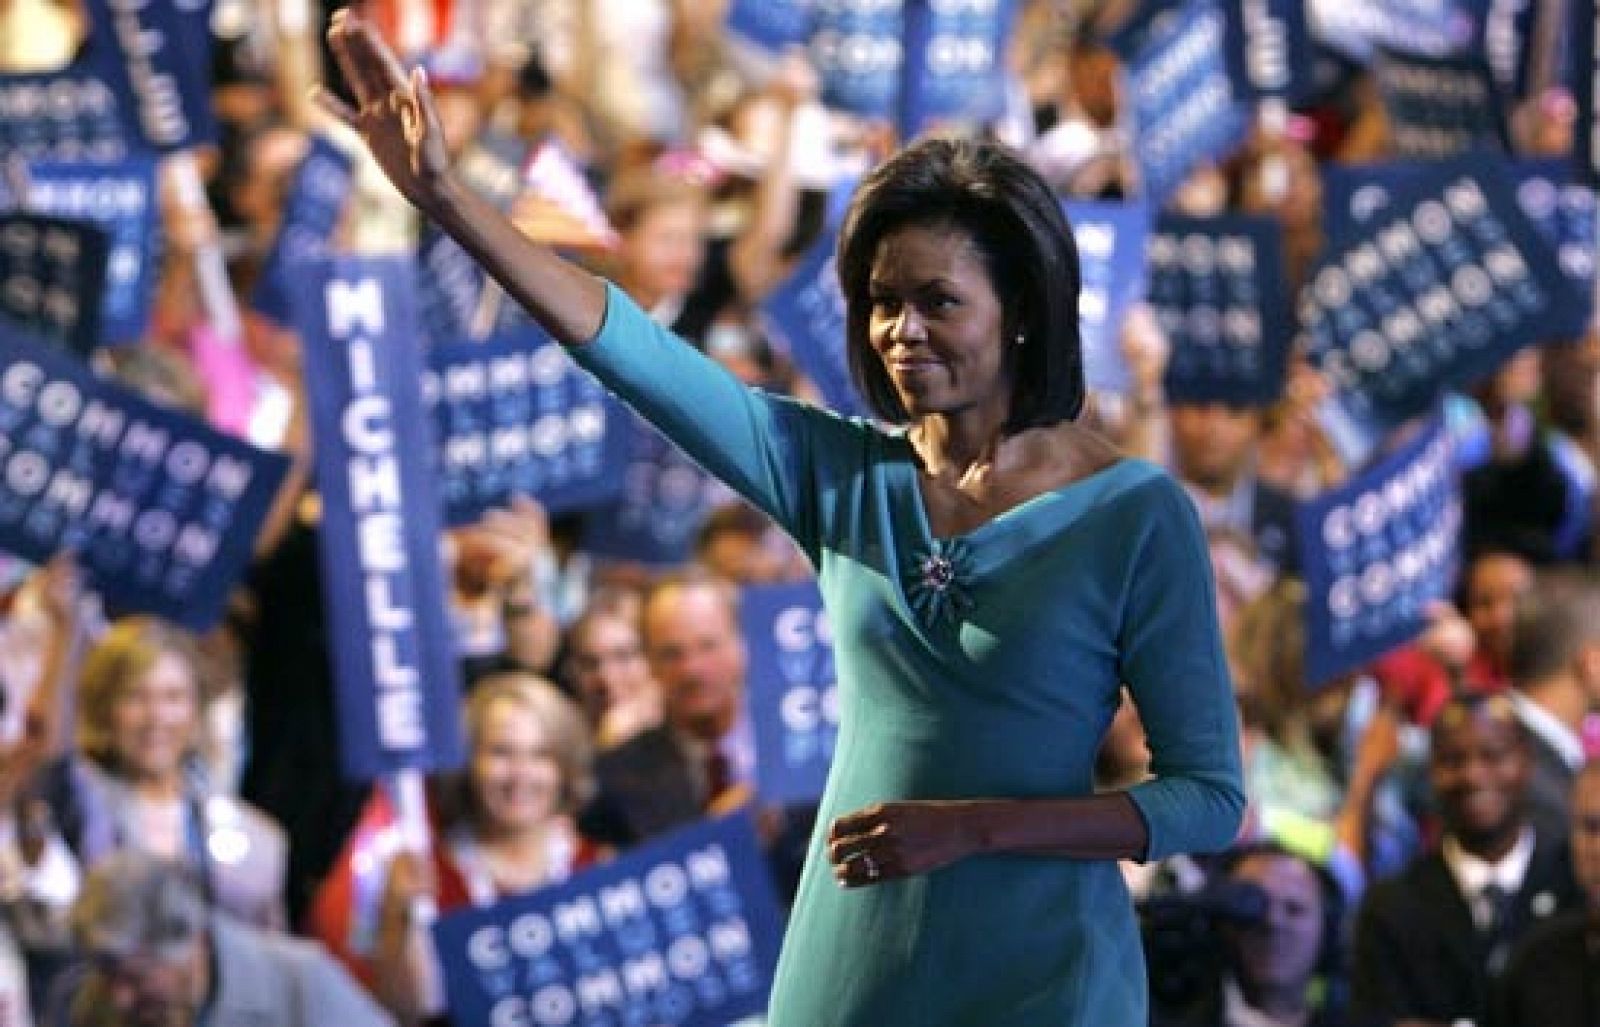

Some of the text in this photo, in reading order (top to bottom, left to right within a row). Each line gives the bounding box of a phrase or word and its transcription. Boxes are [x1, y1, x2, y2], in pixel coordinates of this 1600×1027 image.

[0, 430, 222, 567] OMMON
[2, 361, 253, 501] COMMON
[325, 279, 425, 748] MICHELLE
[467, 845, 730, 970] COMMON
